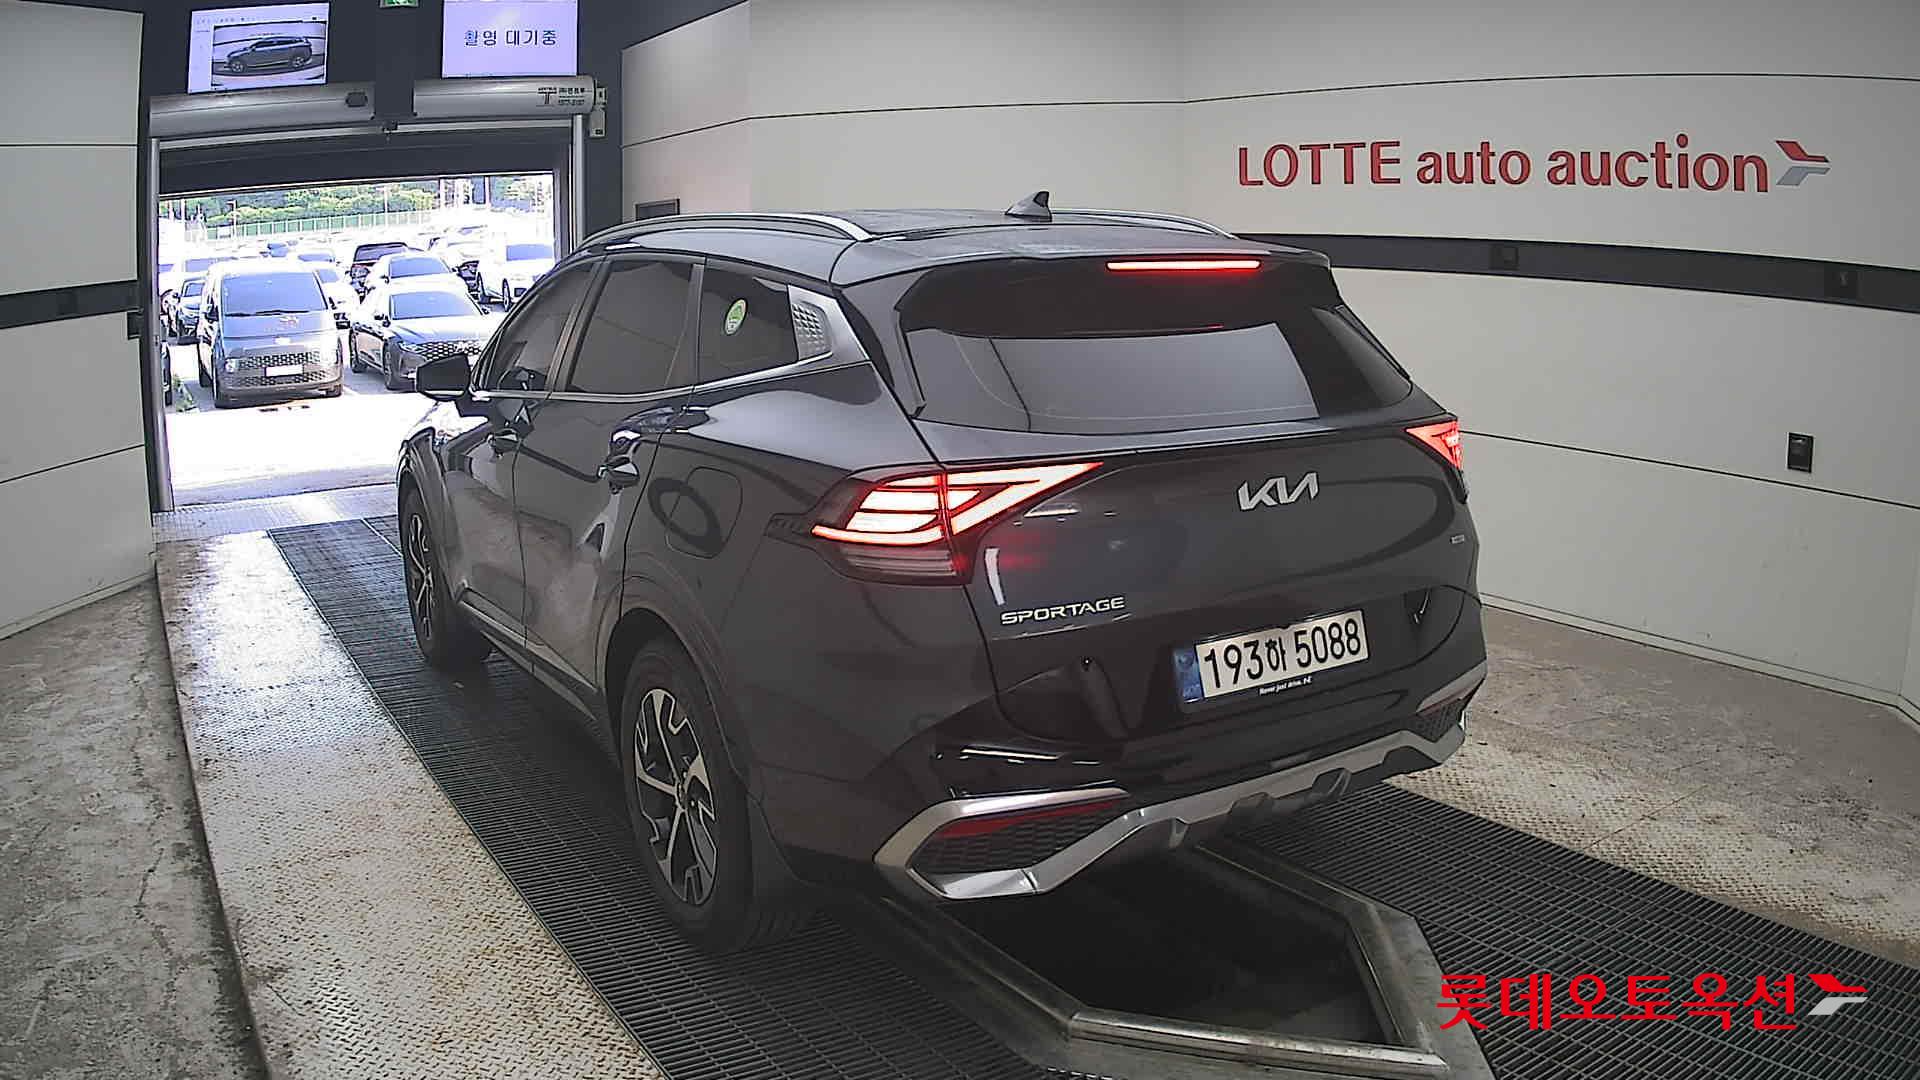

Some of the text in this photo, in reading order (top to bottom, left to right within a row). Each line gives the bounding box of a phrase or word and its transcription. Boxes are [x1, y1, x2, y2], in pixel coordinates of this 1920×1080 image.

[464, 29, 557, 47] 촬영 대기중
[1239, 133, 1768, 193] LOTTE auto auction
[1238, 472, 1319, 510] KIA
[1001, 597, 1125, 625] SPORTAGE
[1204, 618, 1361, 689] 193하 5088
